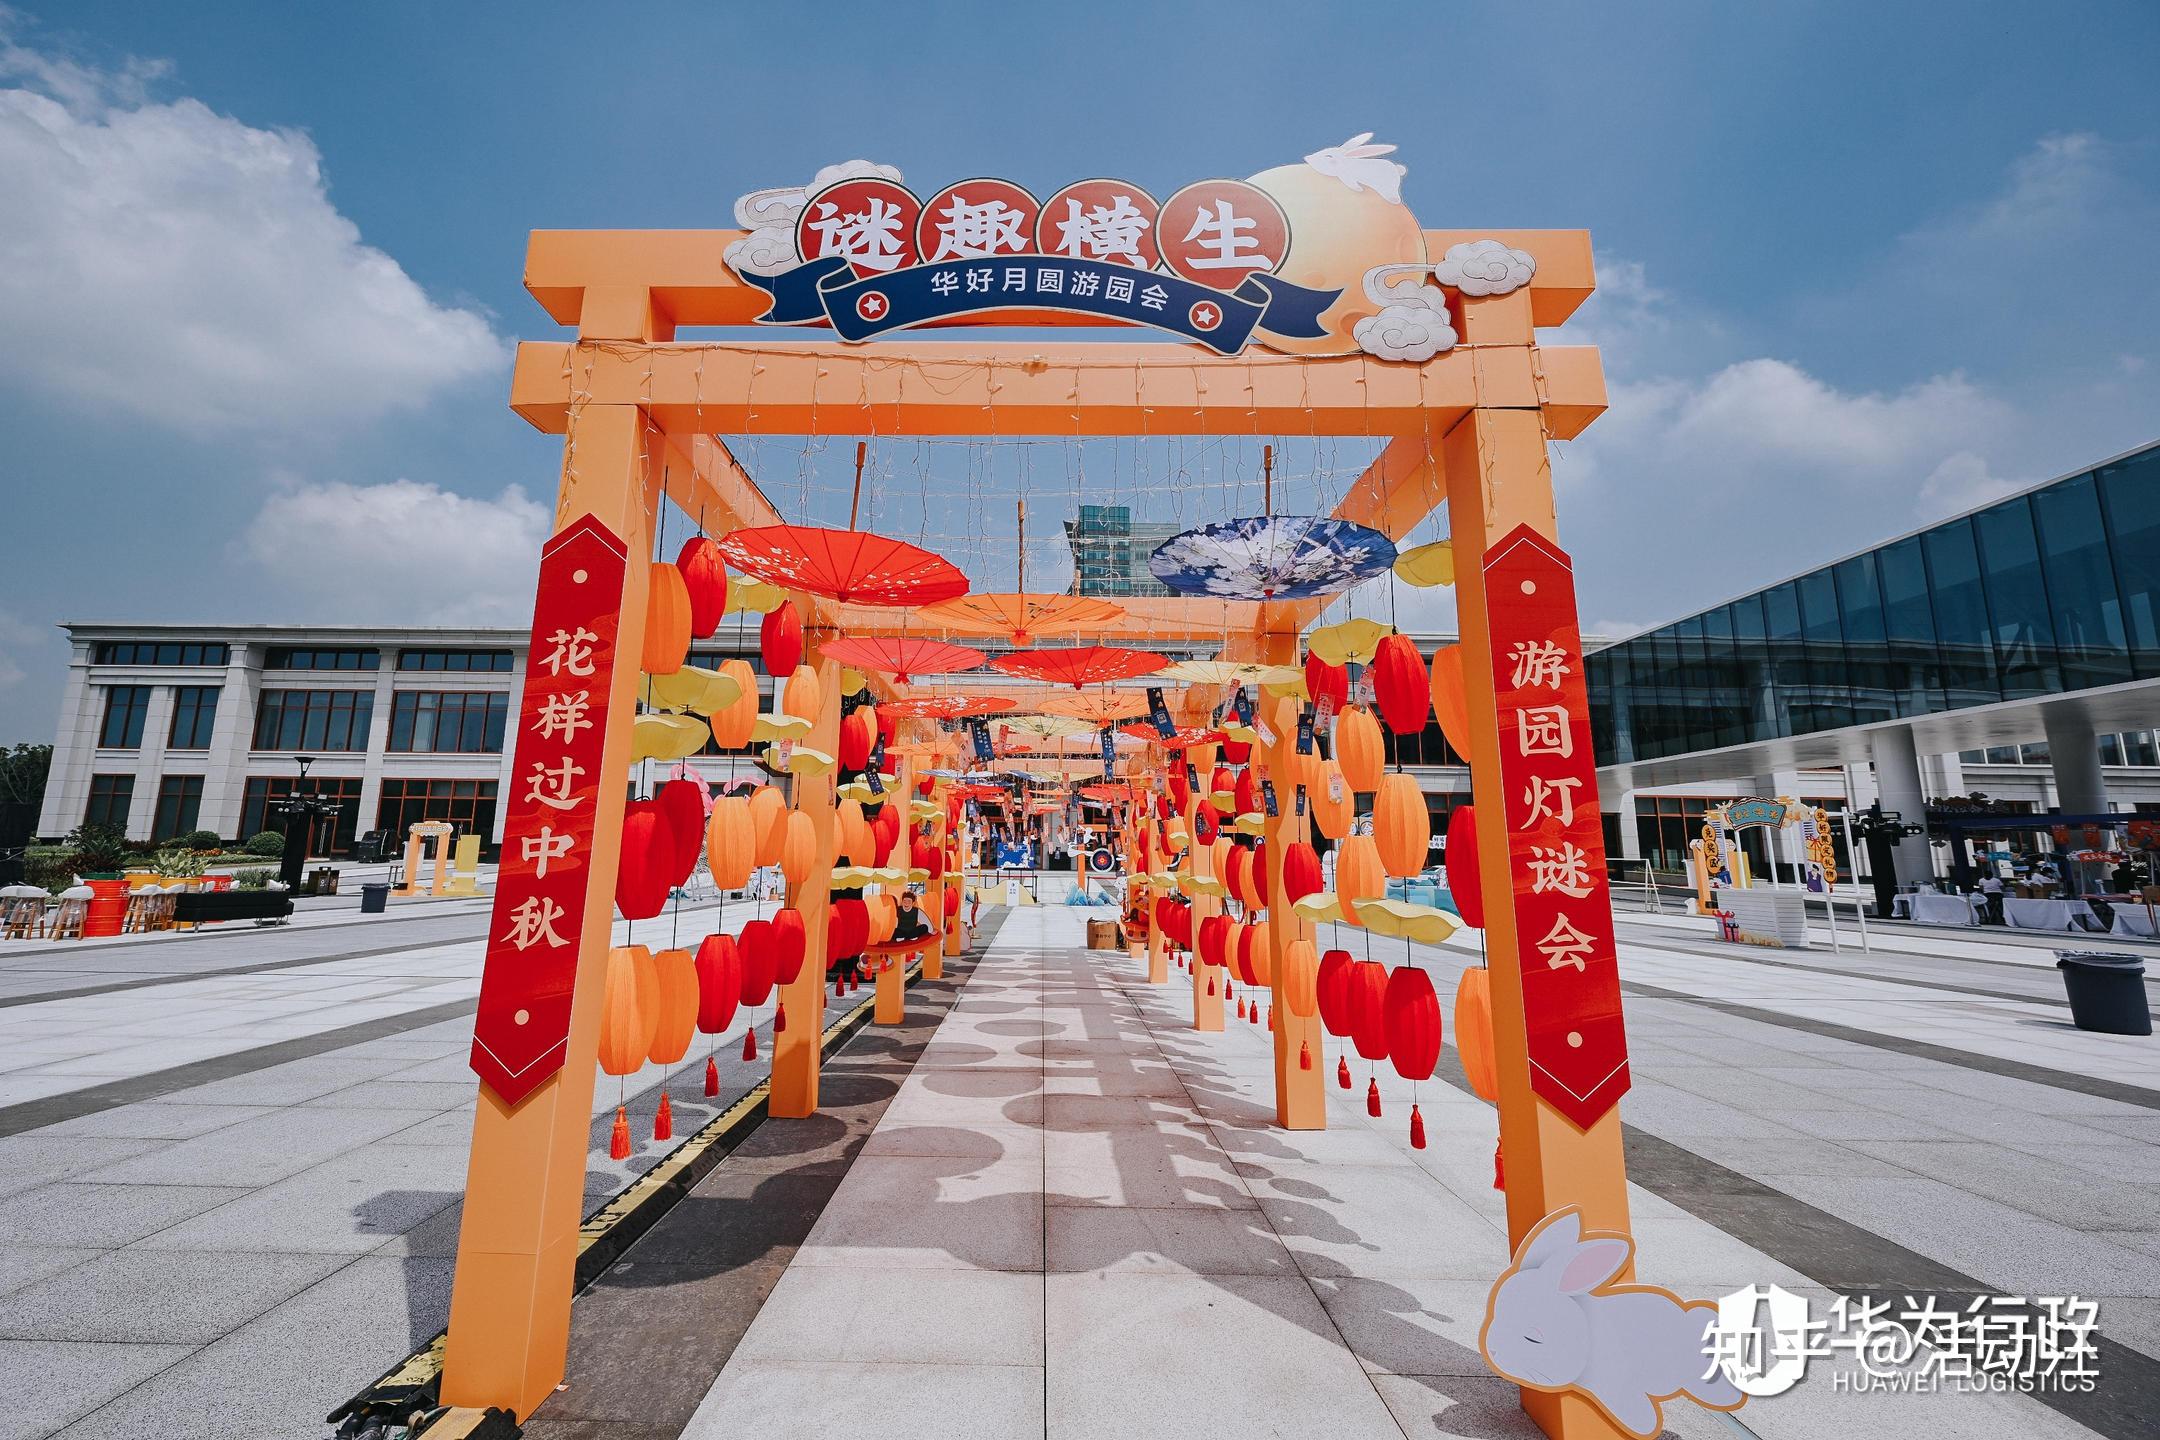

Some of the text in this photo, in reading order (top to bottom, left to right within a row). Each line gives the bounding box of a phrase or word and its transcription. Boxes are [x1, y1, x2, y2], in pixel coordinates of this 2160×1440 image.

[807, 194, 1275, 271] 谜趣横生
[931, 267, 1169, 311] 华好月圆游园会
[500, 627, 599, 951] 花样过中秋
[1506, 639, 1598, 973] 游园灯谜会
